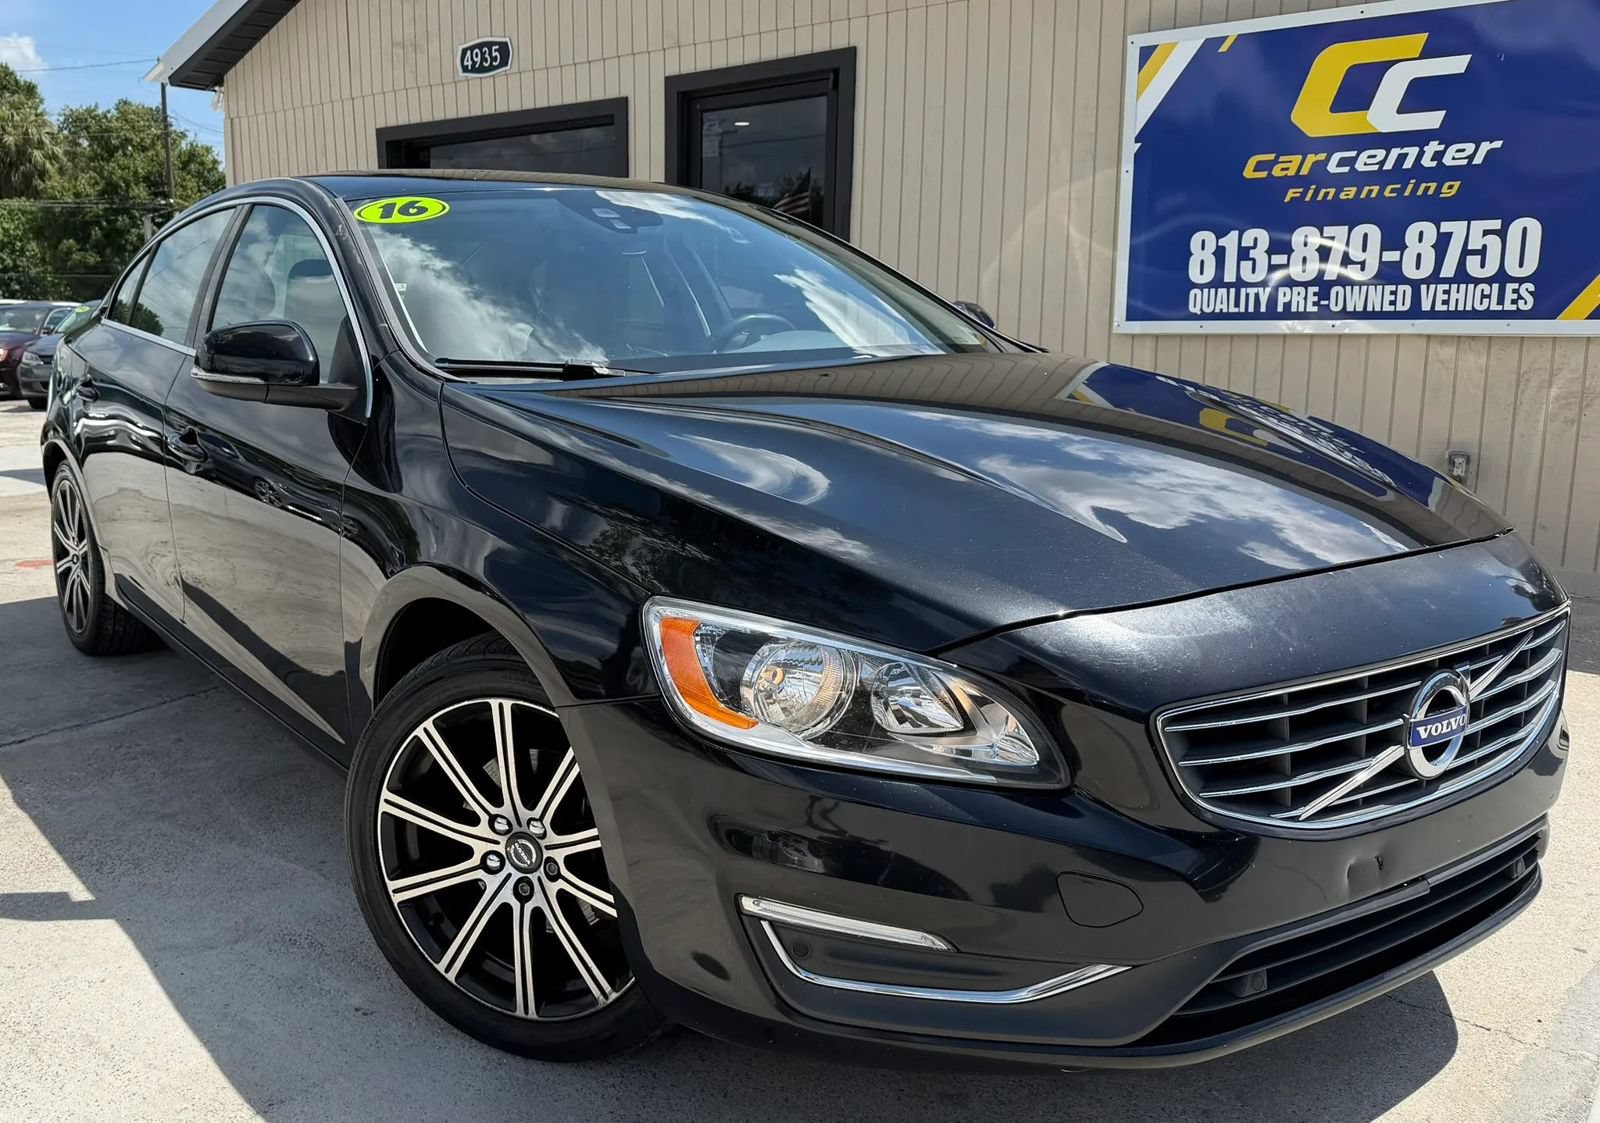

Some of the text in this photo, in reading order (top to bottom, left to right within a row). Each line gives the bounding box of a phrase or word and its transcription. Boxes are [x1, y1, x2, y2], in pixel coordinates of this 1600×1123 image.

[463, 45, 500, 70] 4935
[1284, 179, 1460, 203] Financing
[377, 200, 429, 219] 16
[1188, 217, 1542, 284] 813-879-8750
[1188, 283, 1535, 315] QUALITY PRE-OWNED VEHICLES
[1416, 714, 1467, 739] VOLVO
